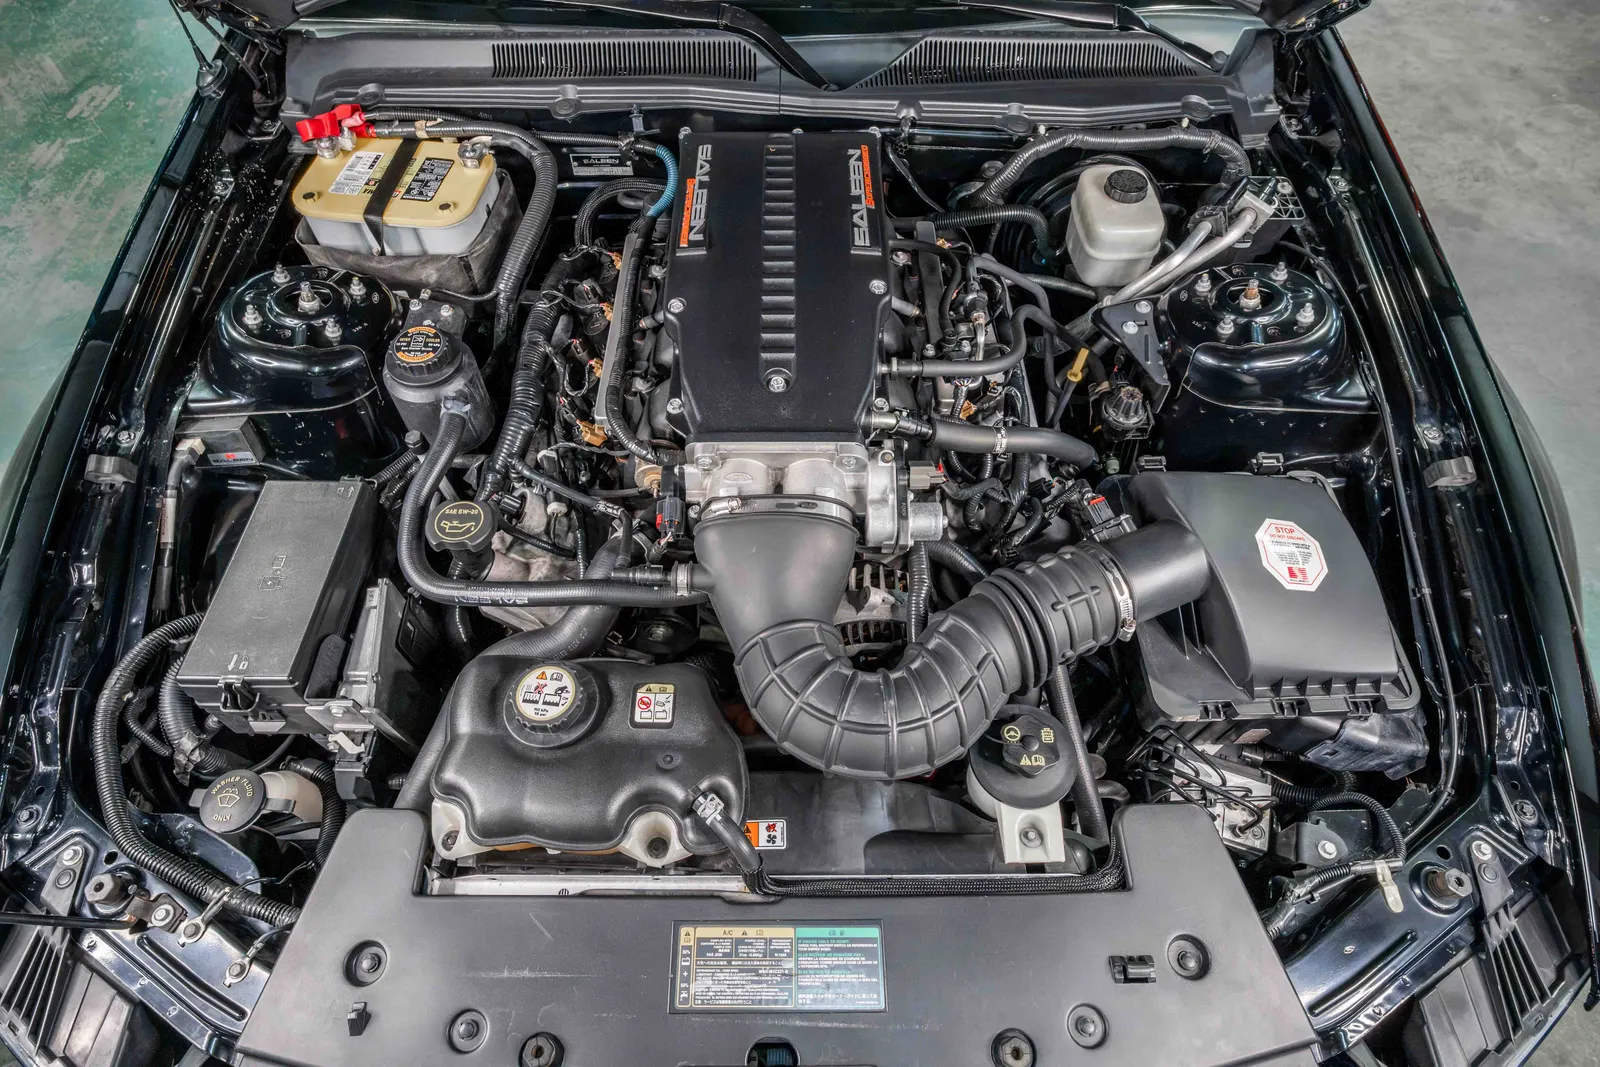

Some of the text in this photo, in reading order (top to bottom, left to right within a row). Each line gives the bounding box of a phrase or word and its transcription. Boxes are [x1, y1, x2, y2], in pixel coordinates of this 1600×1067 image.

[688, 144, 712, 241] SALEEN
[847, 148, 870, 246] SALEEN
[211, 776, 253, 797] WASHER FLUID
[213, 814, 231, 822] ONLY
